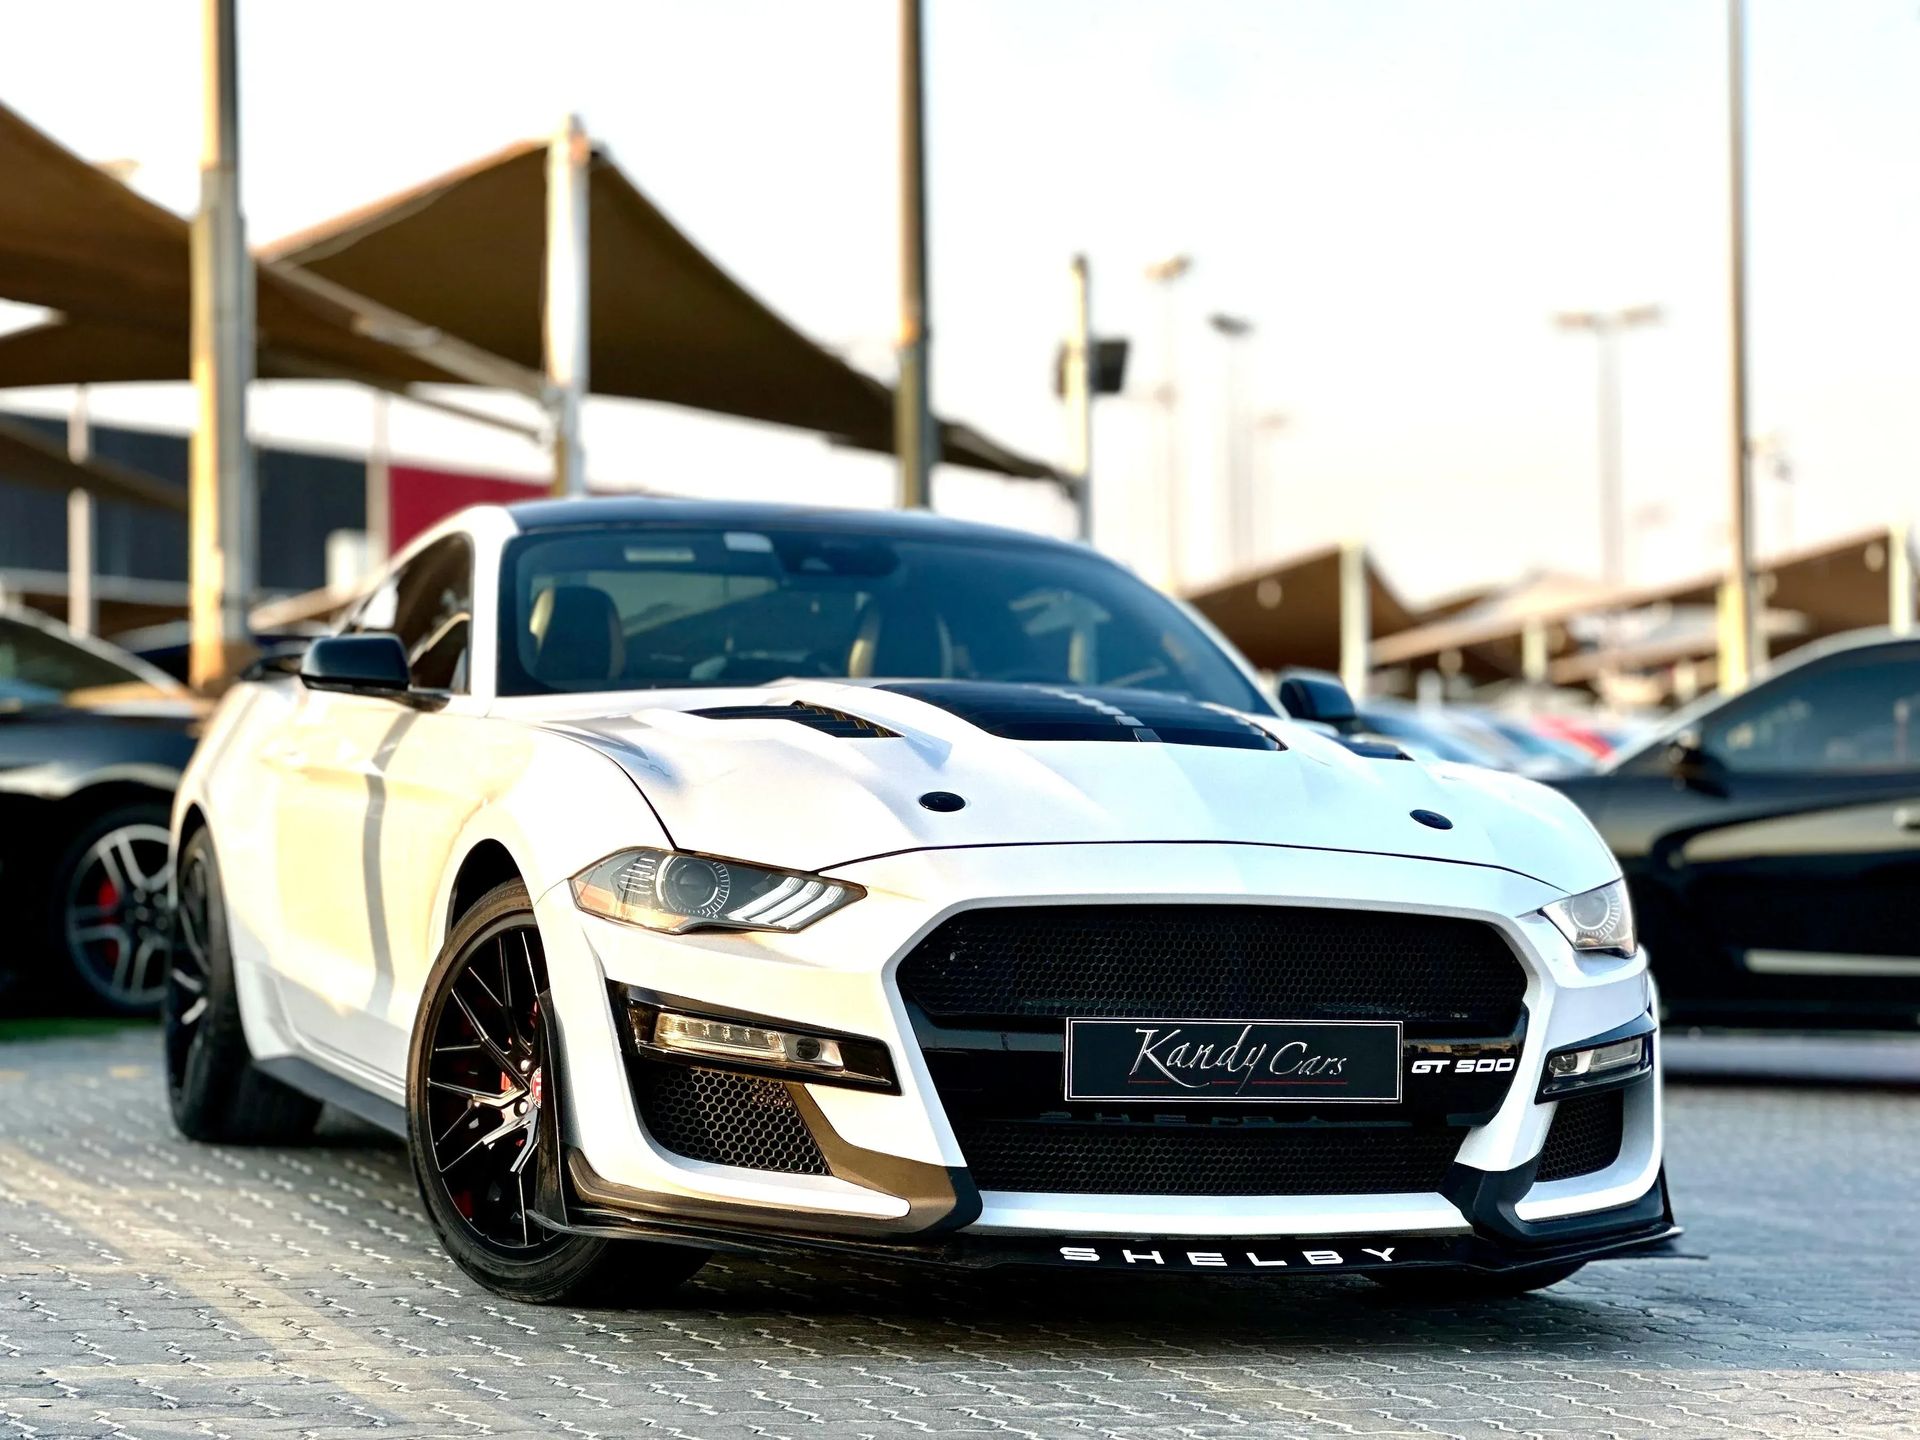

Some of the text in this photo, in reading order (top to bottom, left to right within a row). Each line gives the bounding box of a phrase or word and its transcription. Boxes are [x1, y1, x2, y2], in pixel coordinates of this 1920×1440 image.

[1129, 1024, 1349, 1095] Kandy Cars
[1411, 1058, 1516, 1075] GT 500
[1059, 1246, 1396, 1268] SHELBY
